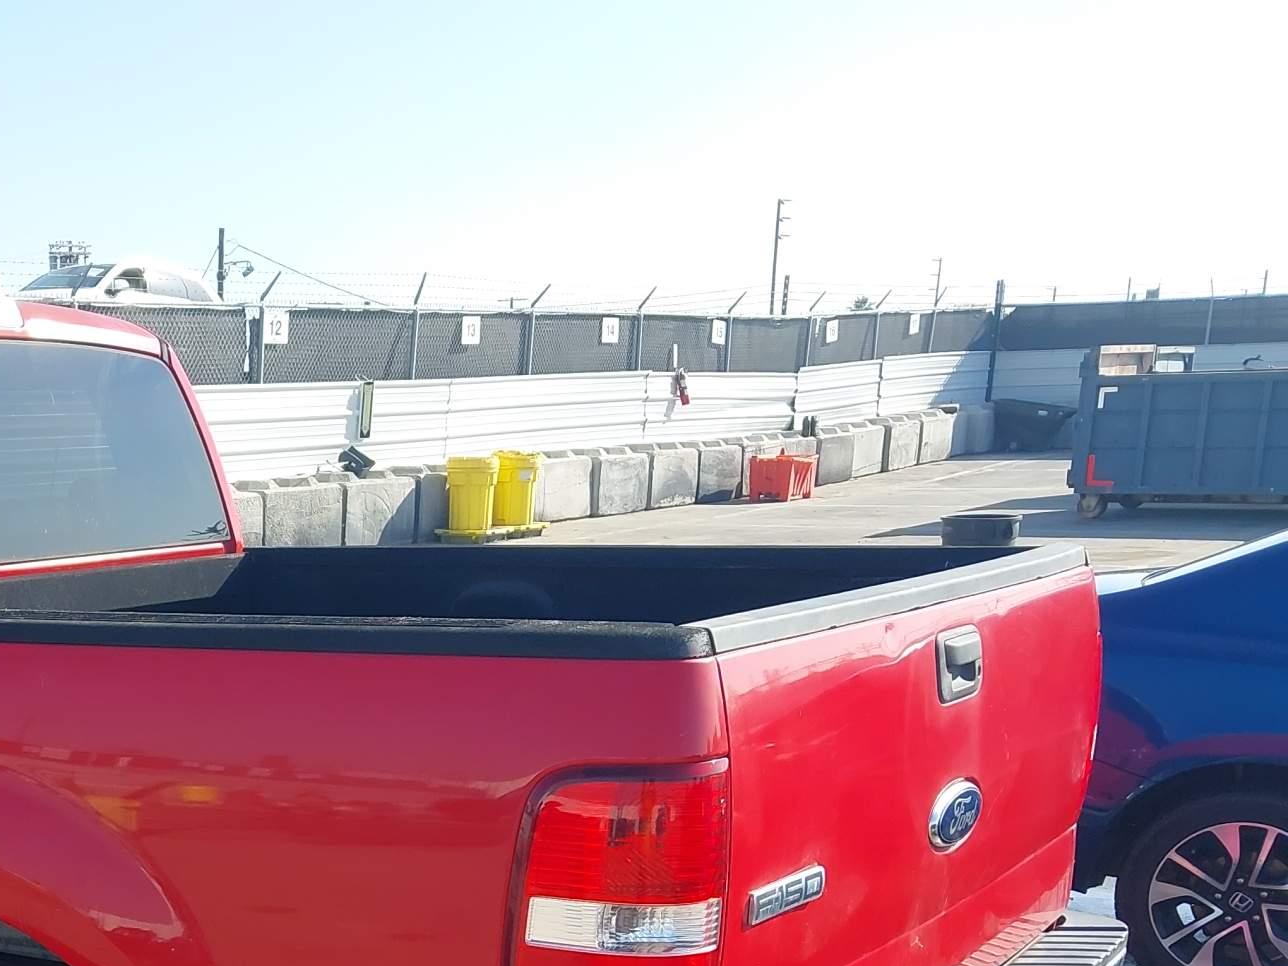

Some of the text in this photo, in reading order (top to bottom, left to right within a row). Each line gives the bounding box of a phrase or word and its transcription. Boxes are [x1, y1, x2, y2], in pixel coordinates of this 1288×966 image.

[269, 320, 283, 336] 12
[467, 323, 476, 337] 13
[949, 795, 979, 835] Ford
